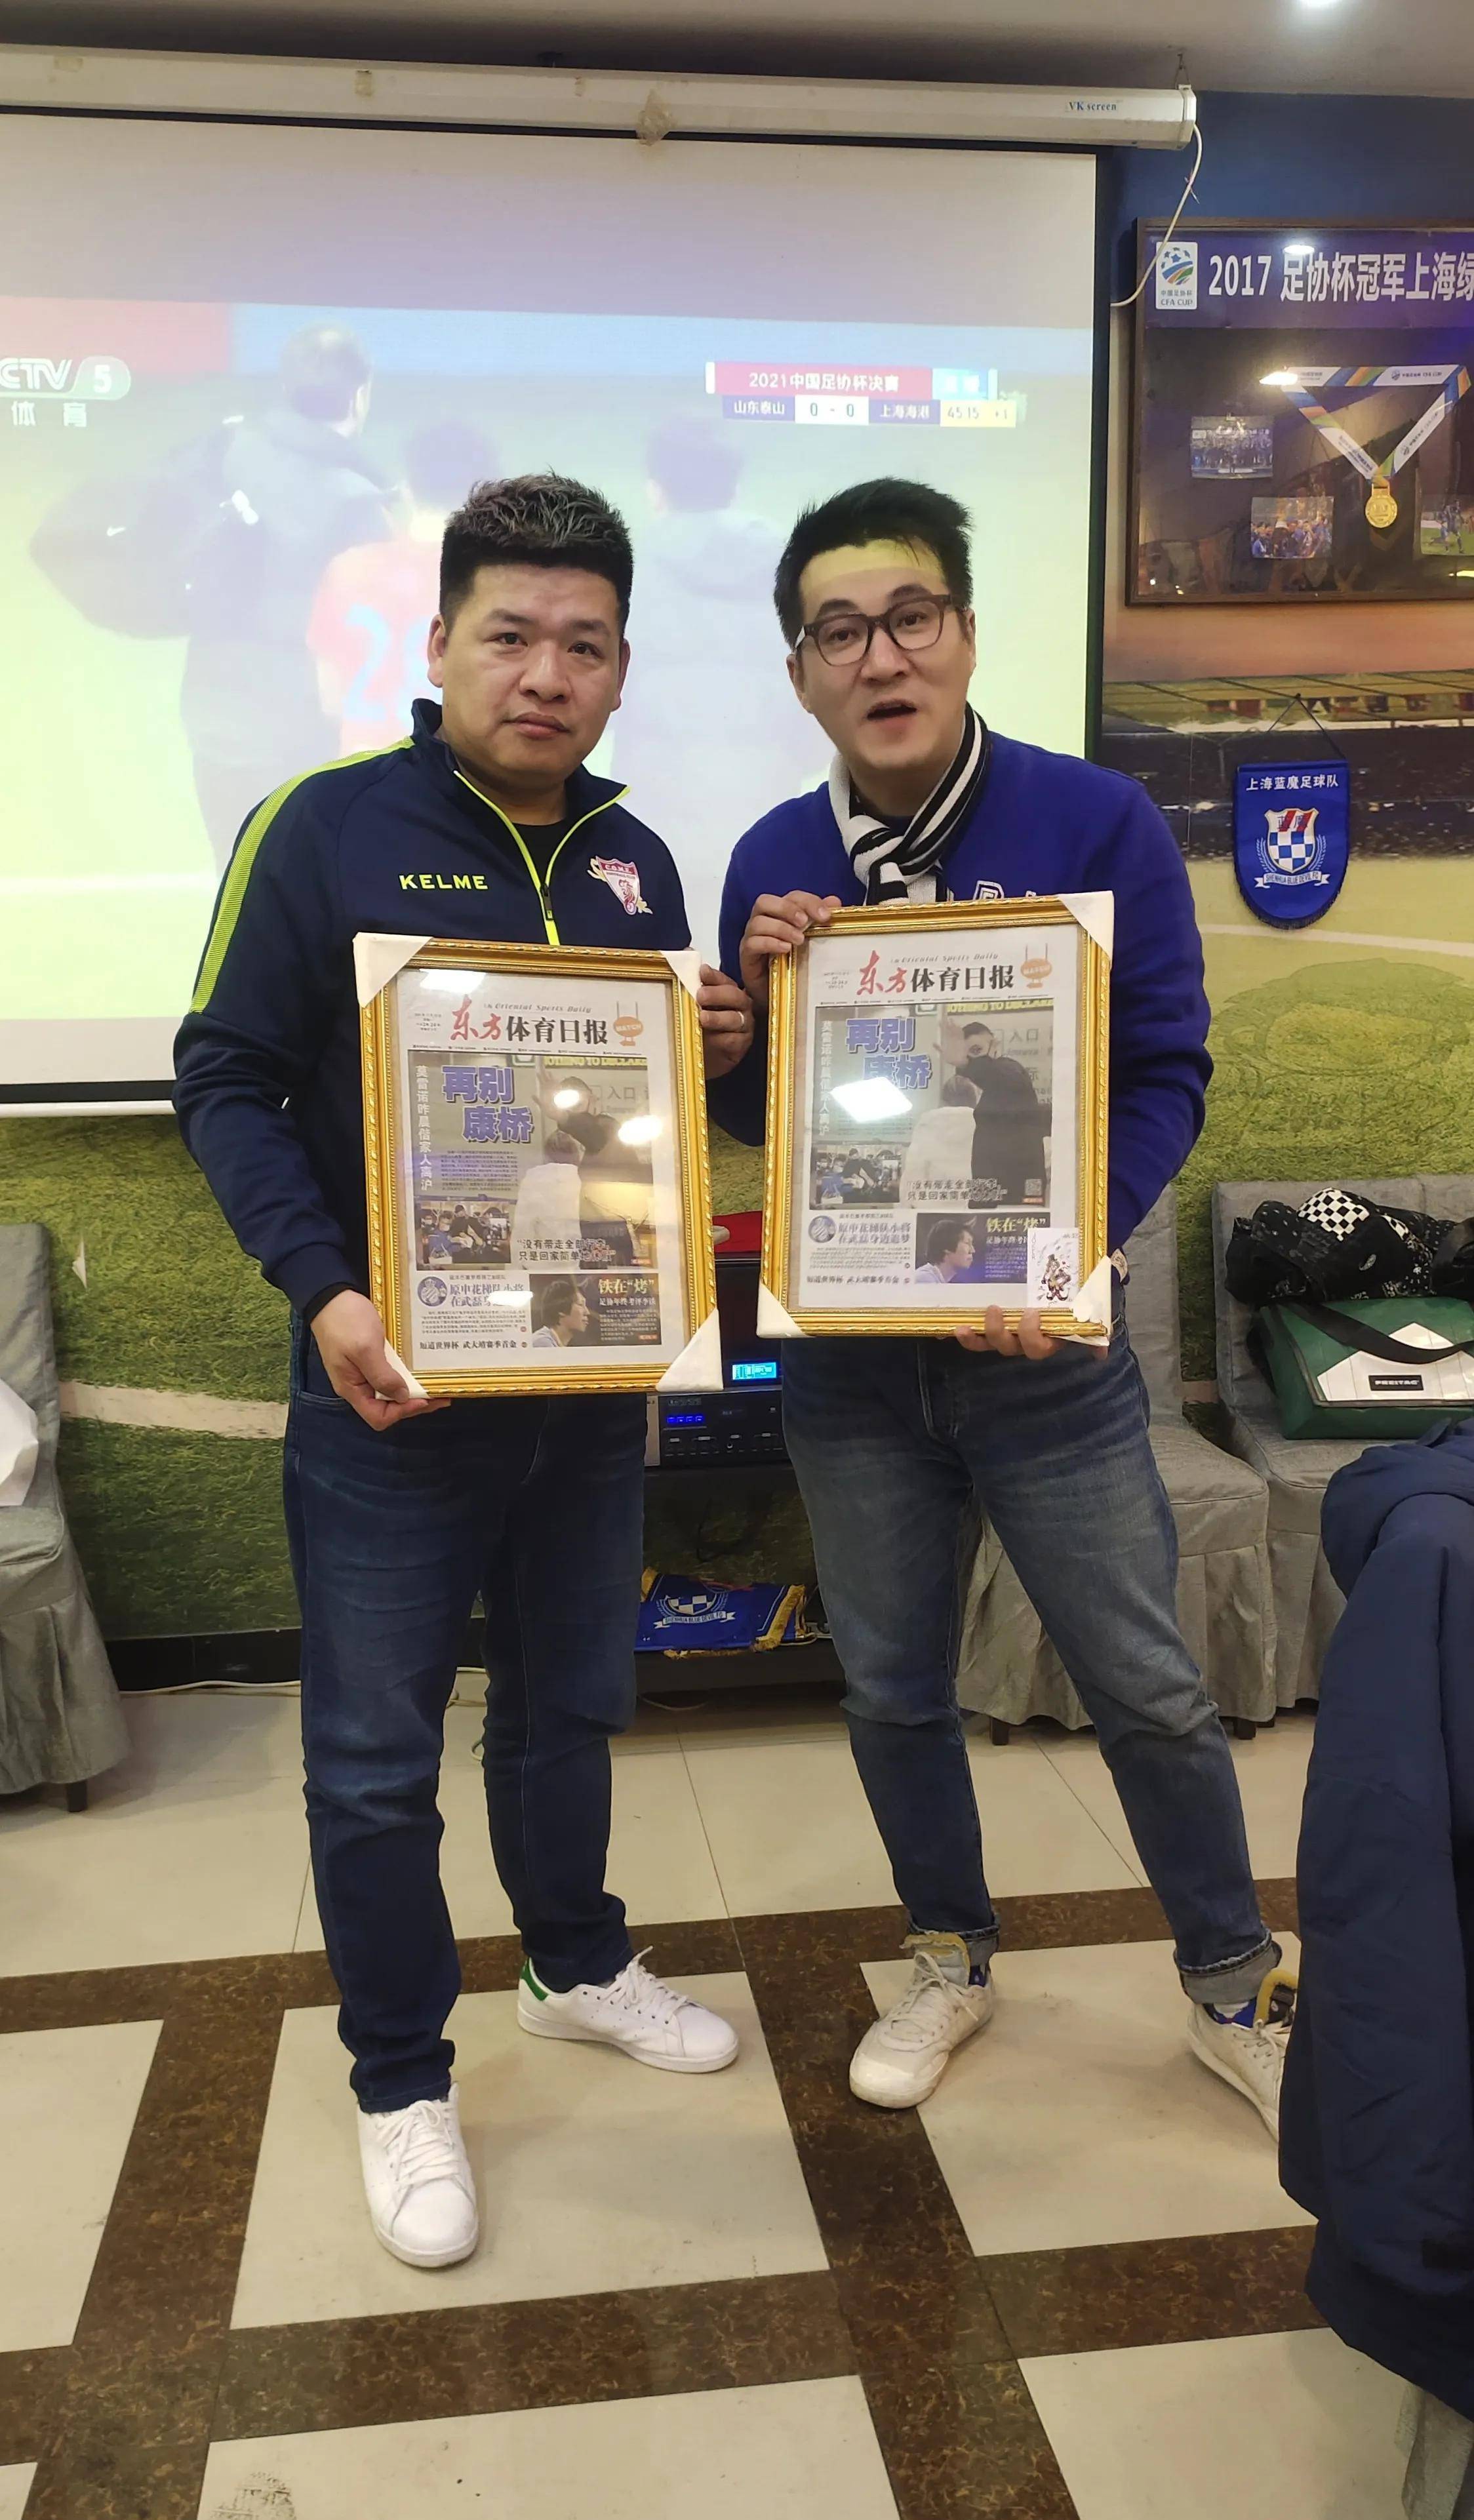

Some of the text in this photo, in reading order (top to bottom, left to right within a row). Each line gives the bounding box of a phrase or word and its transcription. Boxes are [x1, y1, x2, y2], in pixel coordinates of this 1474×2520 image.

[1069, 101, 1084, 111] VK
[1208, 255, 1272, 296] 2017
[94, 365, 112, 393] 5
[749, 372, 899, 391] 2021中国足协杯决赛
[1246, 774, 1339, 791] 上海蓝魔足球队
[399, 873, 488, 890] KELME
[1287, 876, 1298, 885] BLUE
[856, 950, 1014, 995] 东方体育日报
[450, 994, 608, 1045] 东方体育日报
[846, 1017, 915, 1054] 再别
[441, 1065, 515, 1104] 再别
[607, 1086, 636, 1100] 入口
[462, 1106, 535, 1144] 康桥
